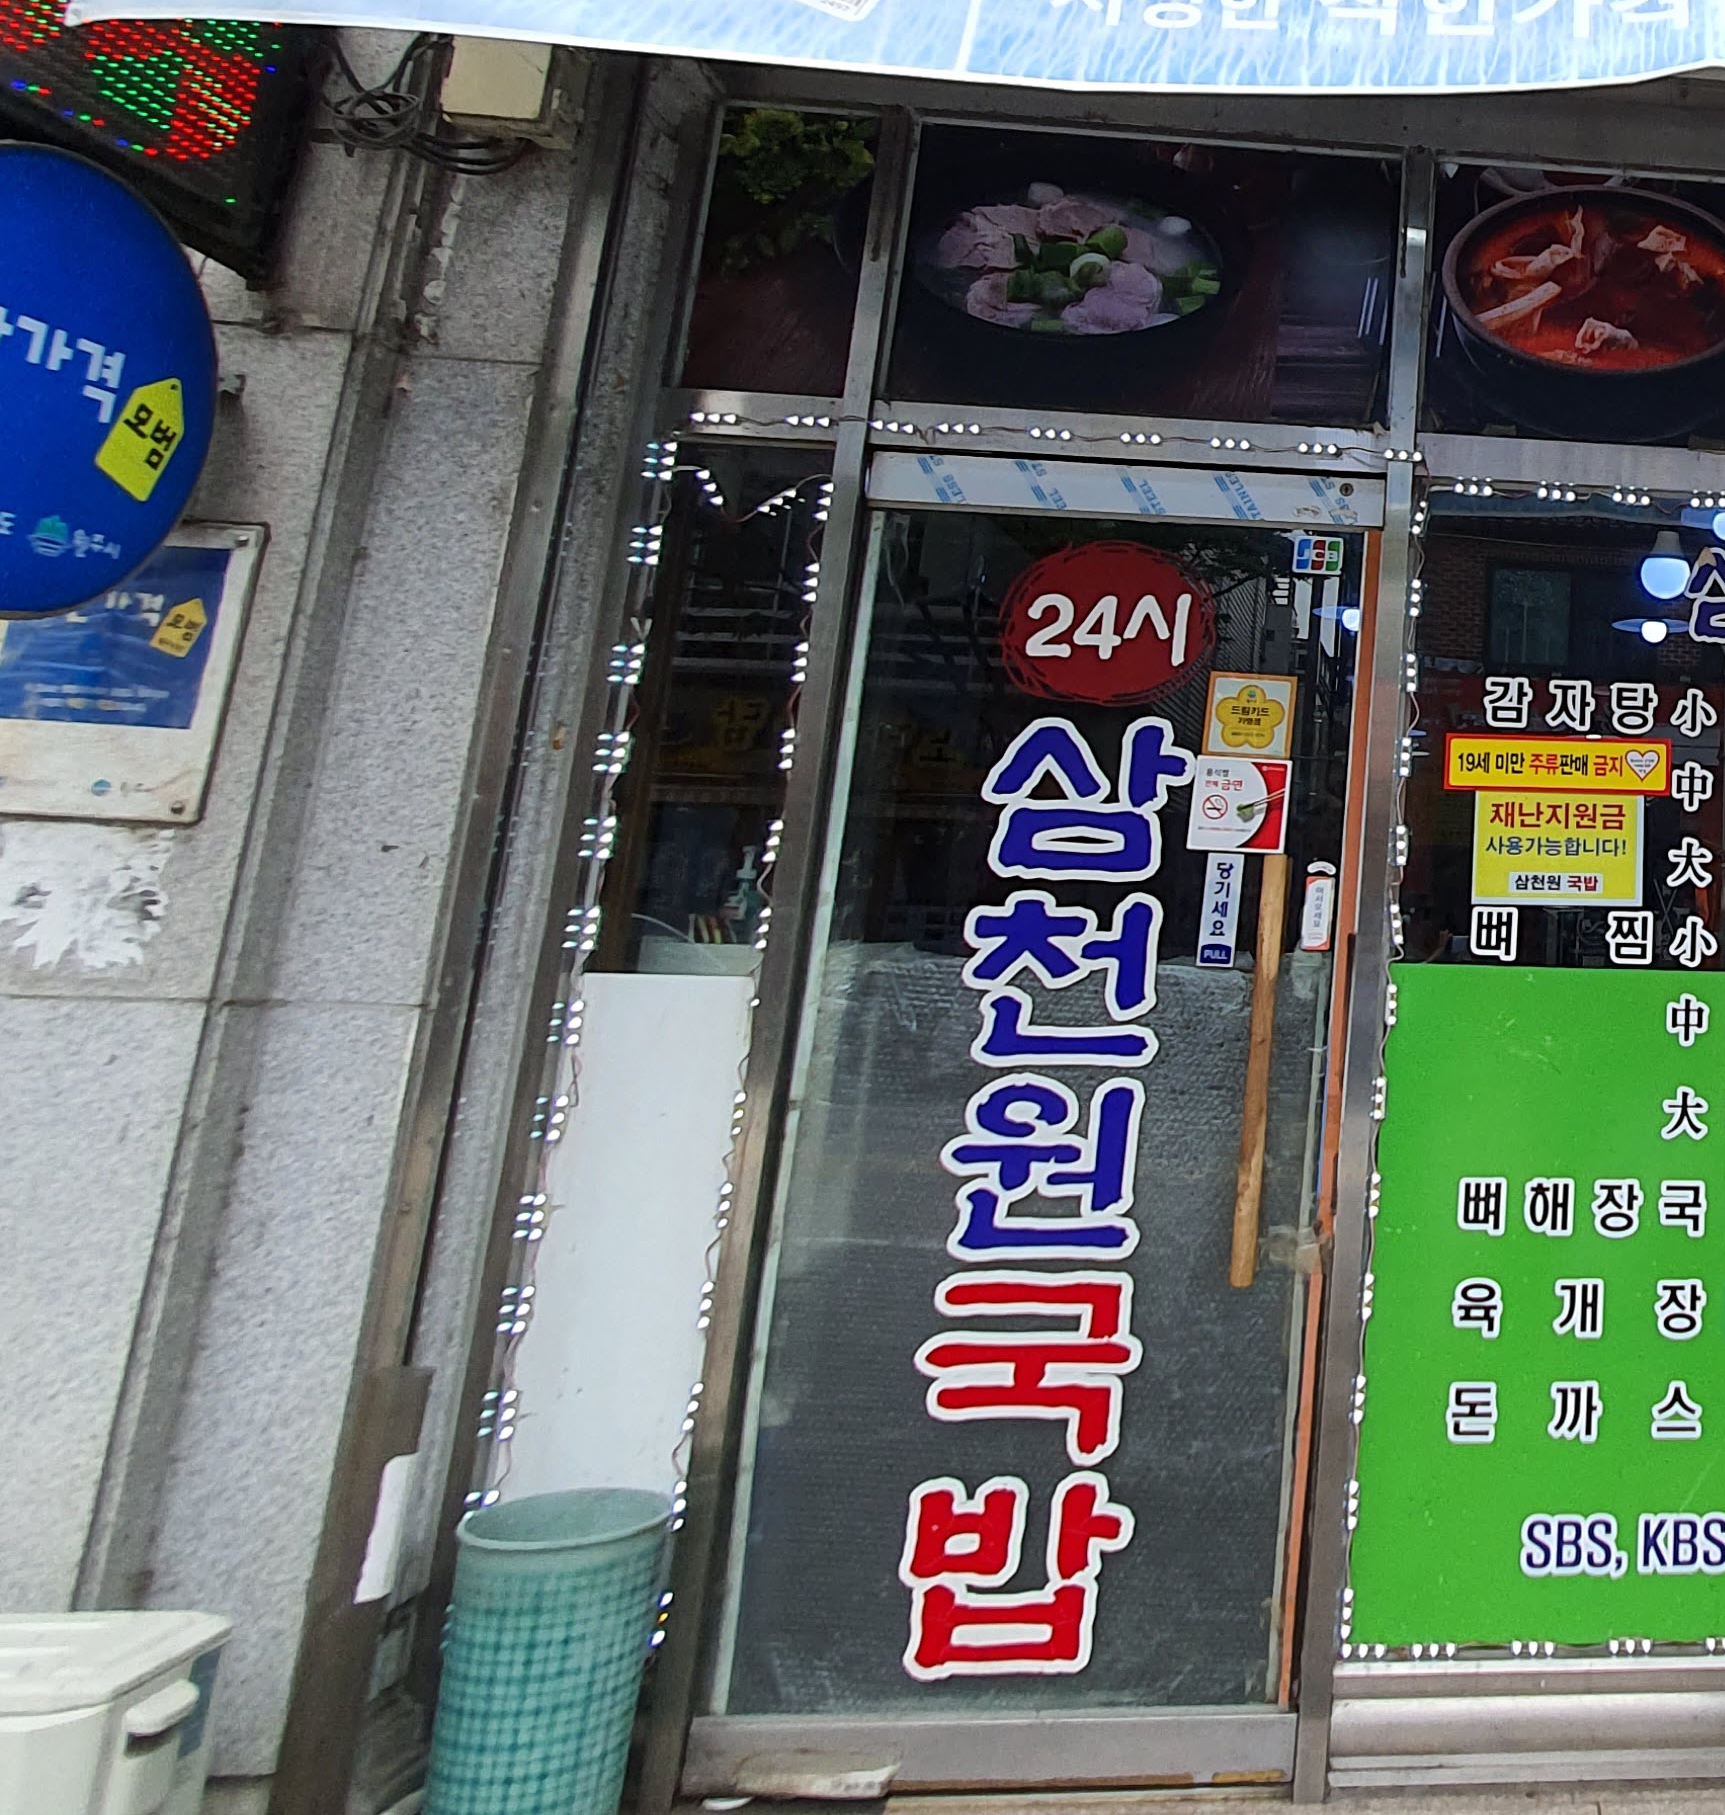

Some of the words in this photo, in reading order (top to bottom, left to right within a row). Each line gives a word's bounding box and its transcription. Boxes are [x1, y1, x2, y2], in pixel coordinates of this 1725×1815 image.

[123, 403, 177, 471] 모범
[1024, 593, 1193, 667] 24시
[1457, 751, 1491, 773] 19세
[1495, 752, 1526, 774] 미만
[1593, 754, 1624, 777] 금지
[1221, 779, 1243, 791] 금연
[1489, 801, 1627, 830] 재난지원금
[1485, 836, 1627, 857] 사용가능합니다!
[1514, 874, 1561, 891] 삼천원
[1566, 875, 1599, 892] 국밥
[1209, 862, 1235, 937] 당기세요
[1519, 1513, 1627, 1579] SBS,
